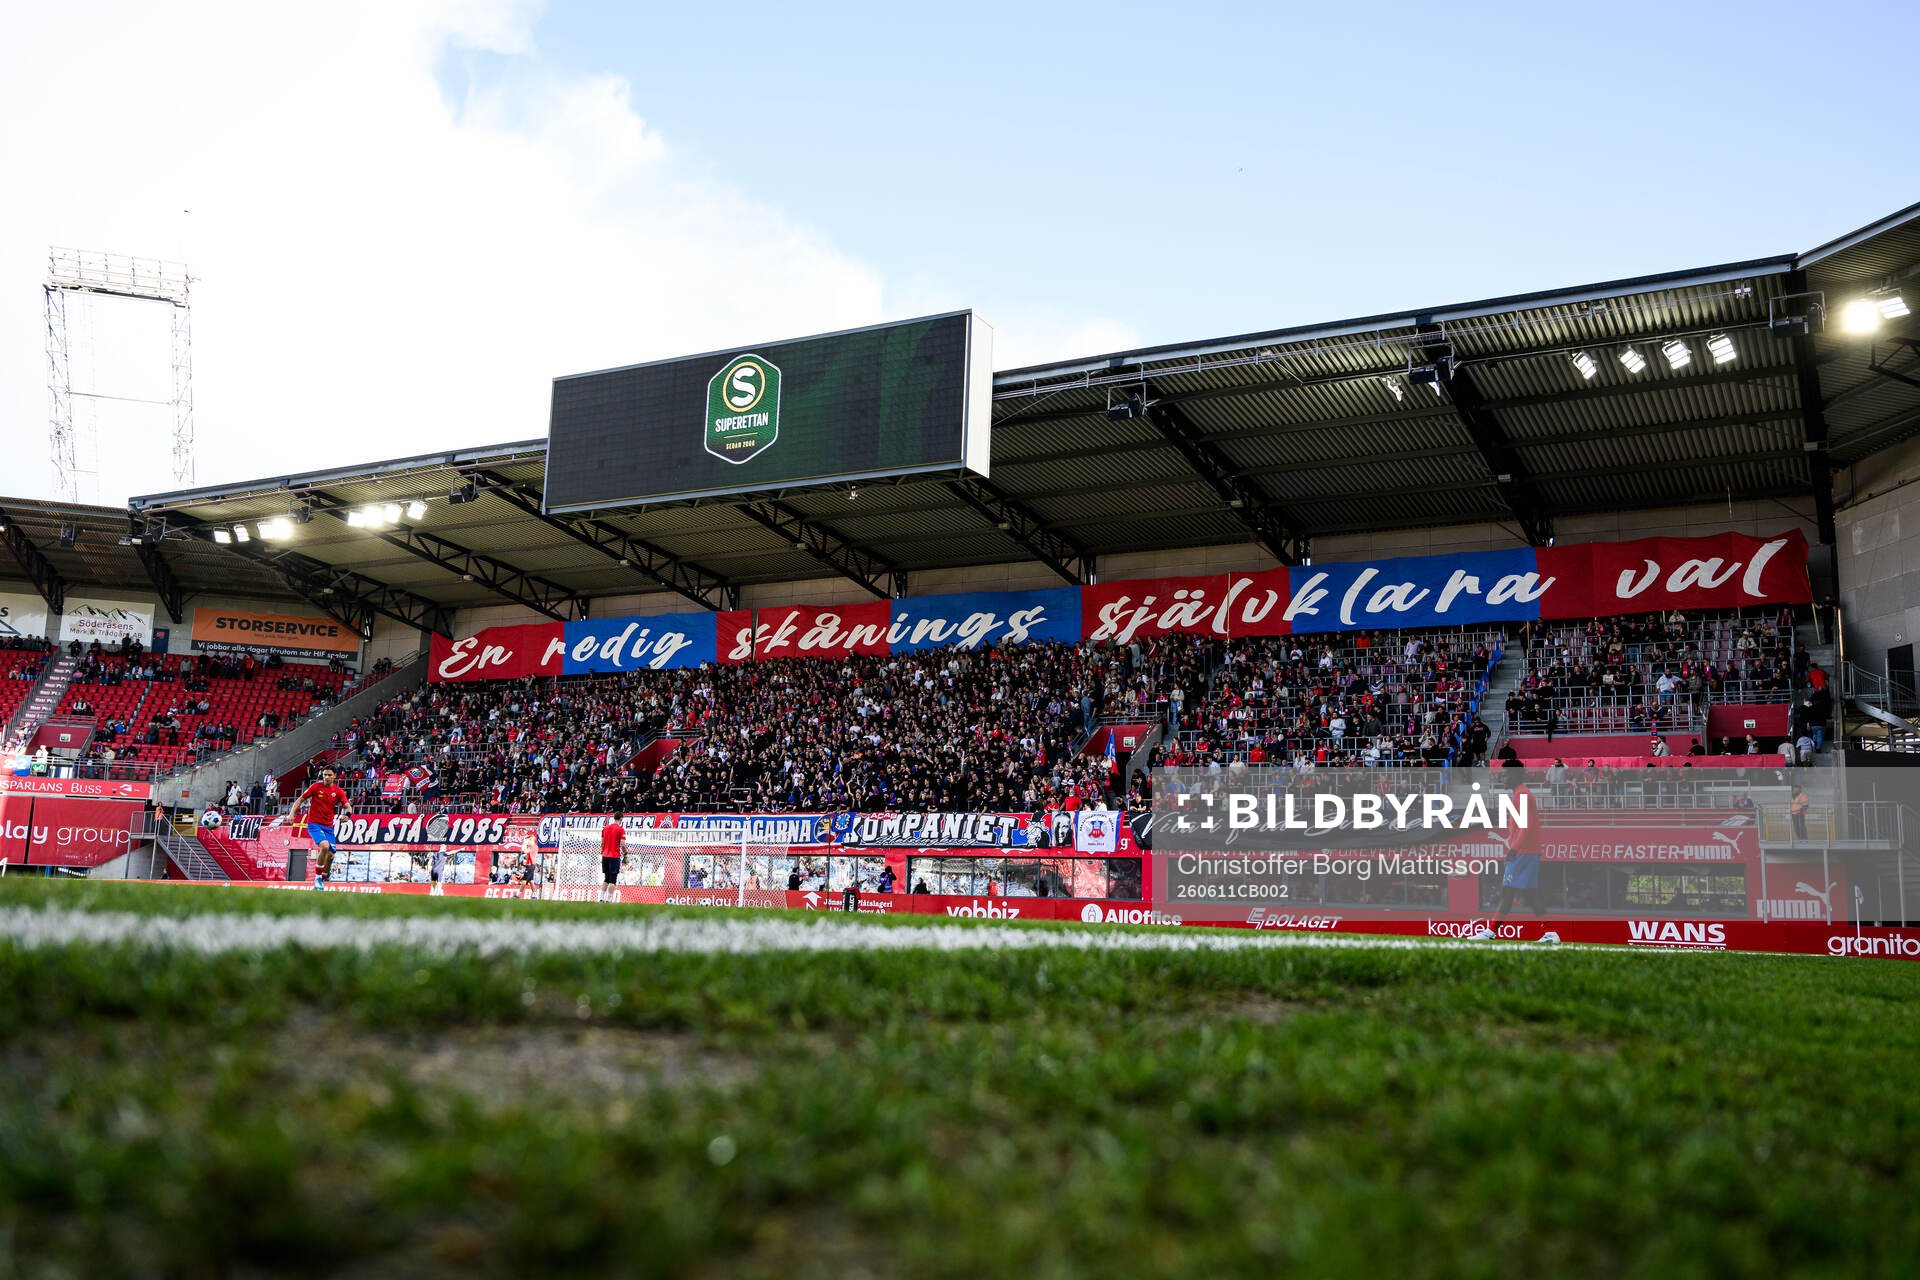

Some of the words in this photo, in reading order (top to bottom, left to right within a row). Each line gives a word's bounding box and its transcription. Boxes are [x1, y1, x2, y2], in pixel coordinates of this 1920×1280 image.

[715, 412, 769, 432] SUPERETTAN
[438, 637, 513, 679] En
[540, 622, 693, 669] redig
[728, 606, 1048, 660] skånings
[1090, 568, 1556, 645] självklara
[1616, 538, 1789, 598] val
[79, 619, 134, 631] Söderåsens
[216, 617, 339, 638] STORSERVICE
[197, 641, 206, 650] Vi
[206, 643, 230, 652] jobbar
[232, 644, 246, 653] alla
[313, 650, 326, 658] HIF
[56, 825, 130, 847] group
[384, 814, 425, 843] STÅ
[449, 817, 508, 843] 1985
[843, 812, 1018, 845] KOMPANIET
[1105, 908, 1183, 926] AllOffice
[1756, 899, 1821, 919] PUMA
[1628, 920, 1726, 943] WANS
